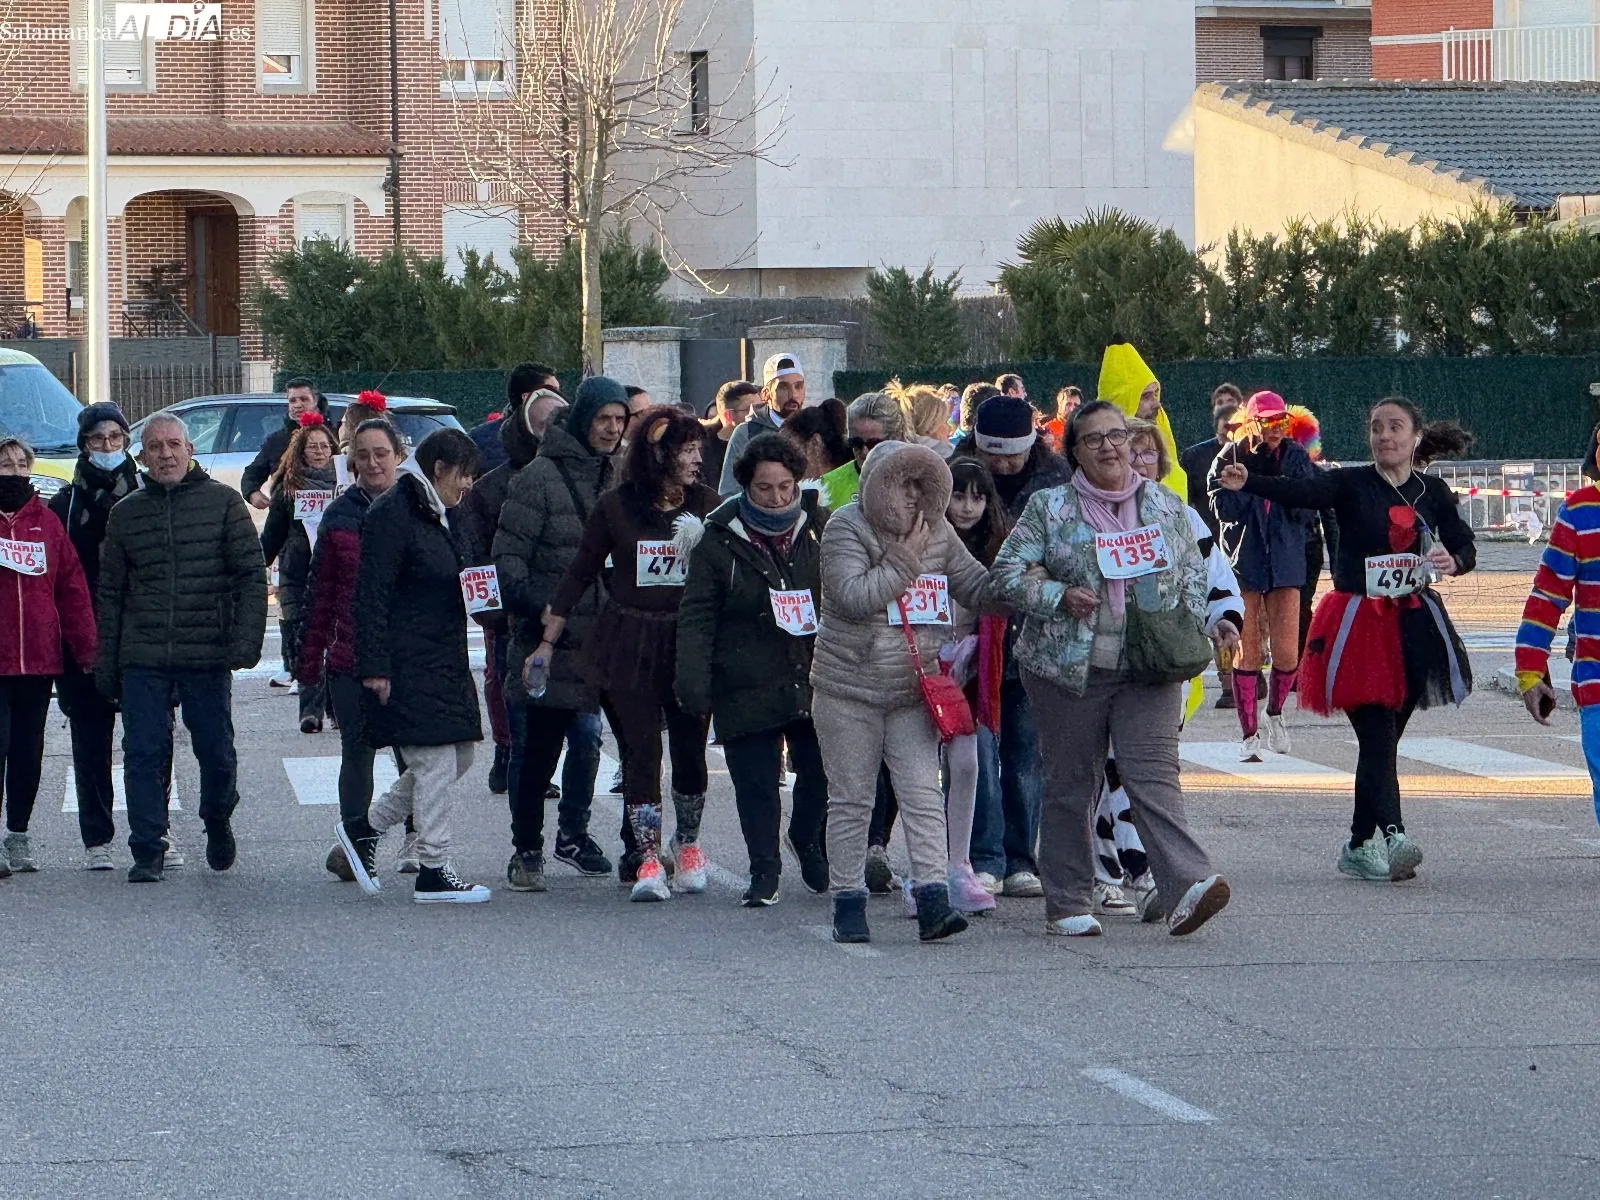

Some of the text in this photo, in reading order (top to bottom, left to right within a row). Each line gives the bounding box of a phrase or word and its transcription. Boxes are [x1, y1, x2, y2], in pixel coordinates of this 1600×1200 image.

[300, 500, 323, 512] 291
[1, 548, 36, 566] 106
[639, 544, 679, 556] bedu
[1110, 541, 1156, 568] 135
[1377, 568, 1417, 589] 494
[462, 581, 489, 602] 05
[900, 590, 938, 612] 231
